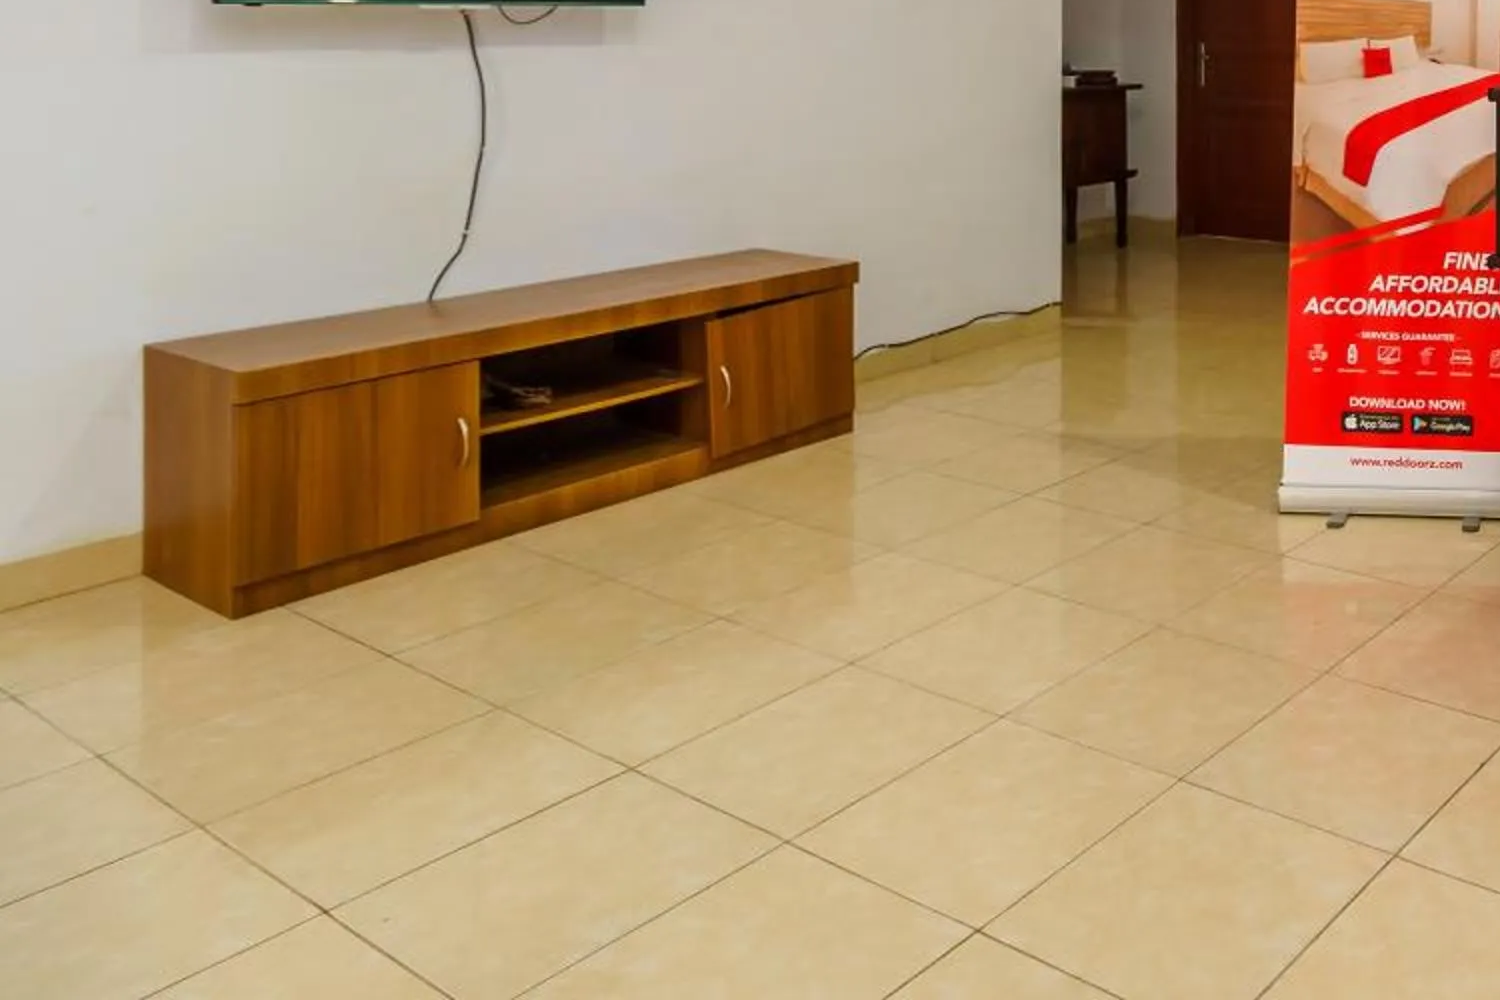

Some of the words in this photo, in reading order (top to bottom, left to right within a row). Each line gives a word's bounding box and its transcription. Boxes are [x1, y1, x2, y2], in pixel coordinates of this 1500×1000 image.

[1443, 251, 1500, 272] FINE
[1349, 396, 1425, 409] DOWNLOAD
[1428, 399, 1466, 411] NOW!
[1359, 420, 1377, 431] App
[1378, 419, 1400, 430] Store
[1350, 456, 1463, 471] www.reddoorz.com
